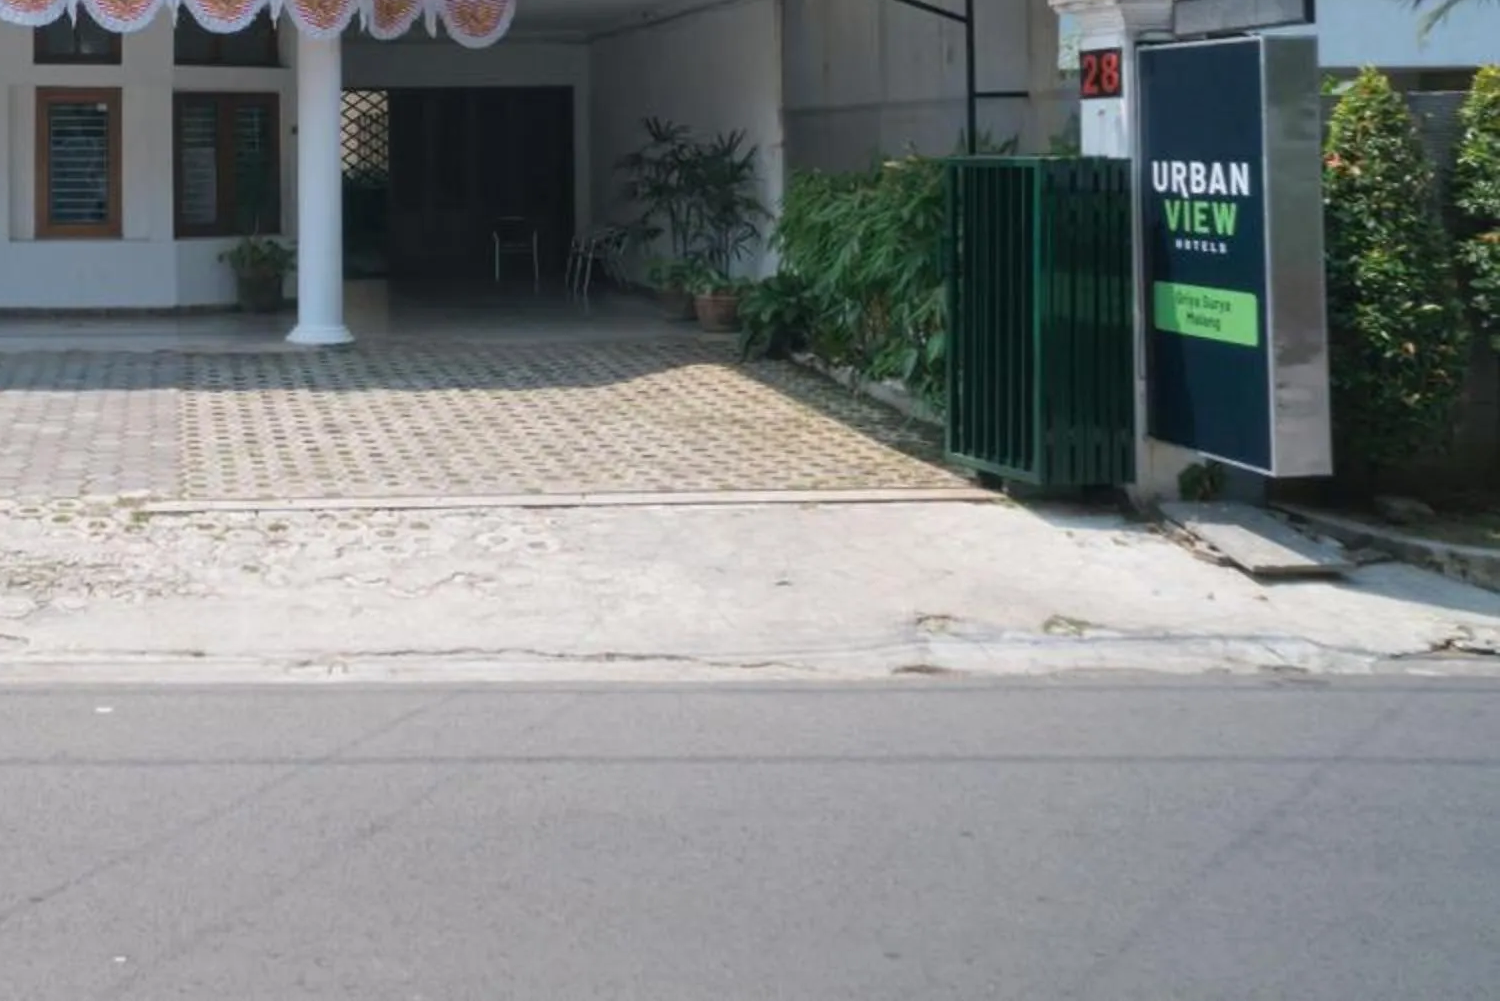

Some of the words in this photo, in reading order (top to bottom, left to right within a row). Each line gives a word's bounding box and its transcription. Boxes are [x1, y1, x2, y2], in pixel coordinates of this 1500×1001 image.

[1083, 53, 1119, 95] 28
[1152, 160, 1249, 198] URBAN
[1165, 199, 1237, 235] VIEW
[1175, 238, 1227, 254] HOTELS
